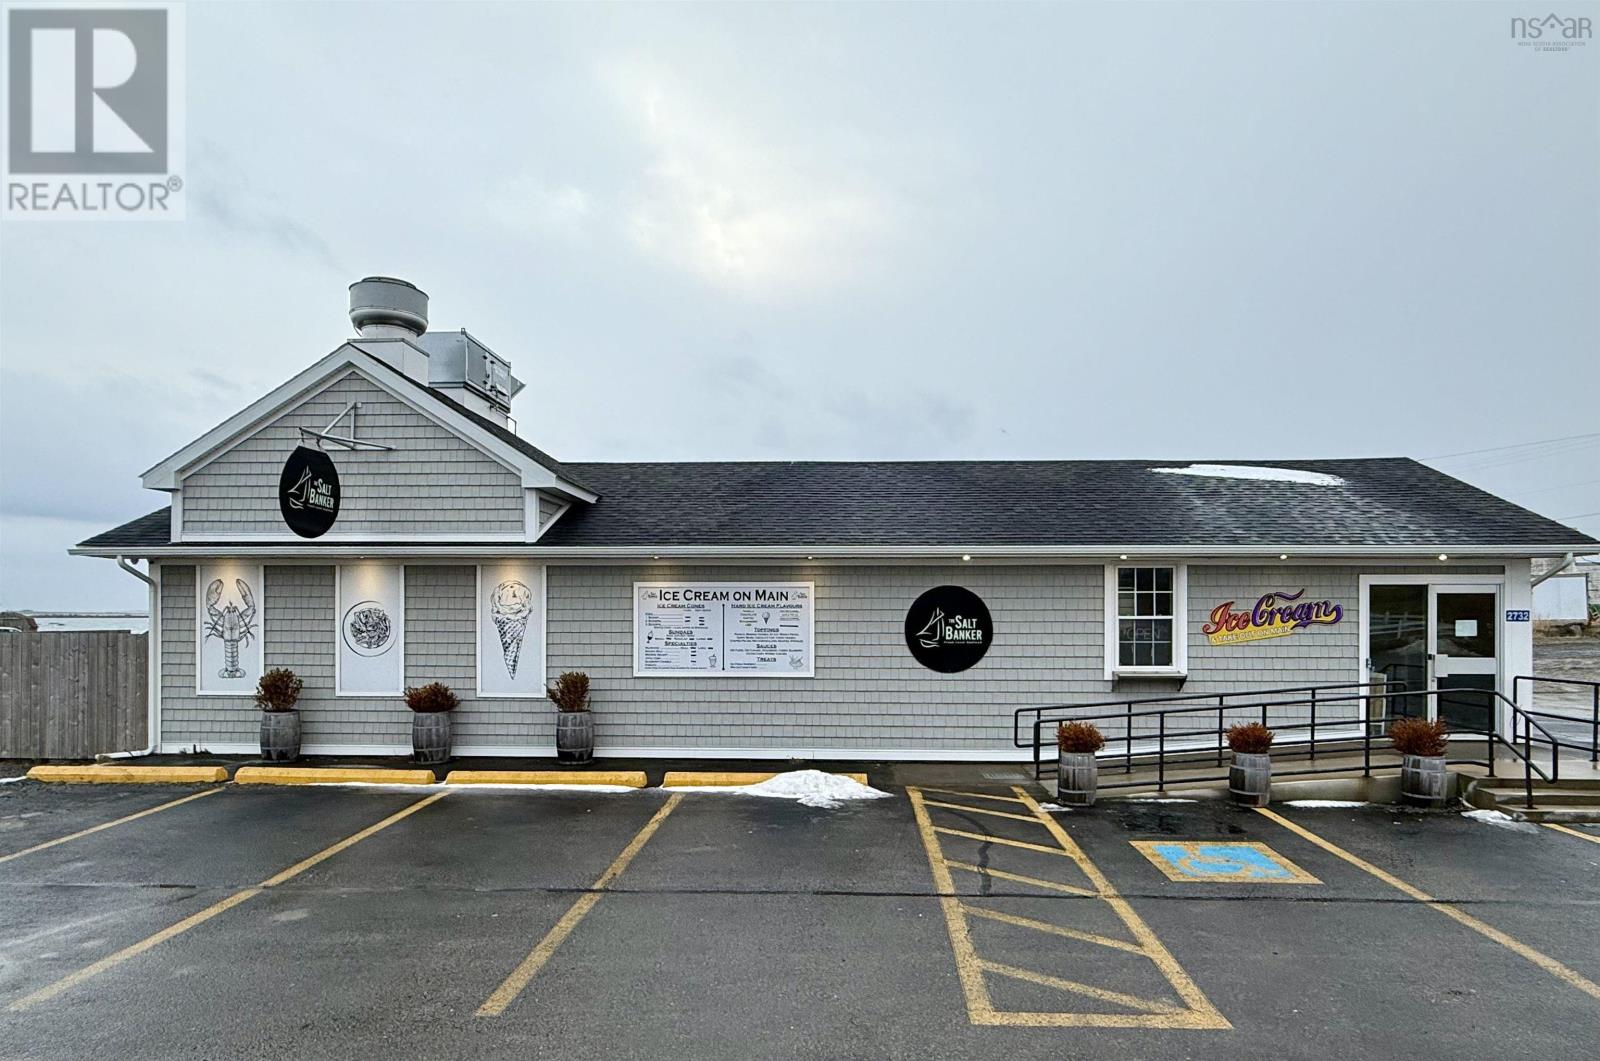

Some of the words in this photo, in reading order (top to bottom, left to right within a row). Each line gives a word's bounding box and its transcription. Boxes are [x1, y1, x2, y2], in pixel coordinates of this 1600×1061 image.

[660, 589, 680, 601] ICE
[683, 589, 730, 601] CREAM
[733, 591, 751, 601] ON
[755, 589, 789, 601] MAIN
[1202, 601, 1250, 634] Ice
[1252, 588, 1343, 630] Cream
[1507, 611, 1529, 620] 2732
[946, 626, 982, 640] BANKER
